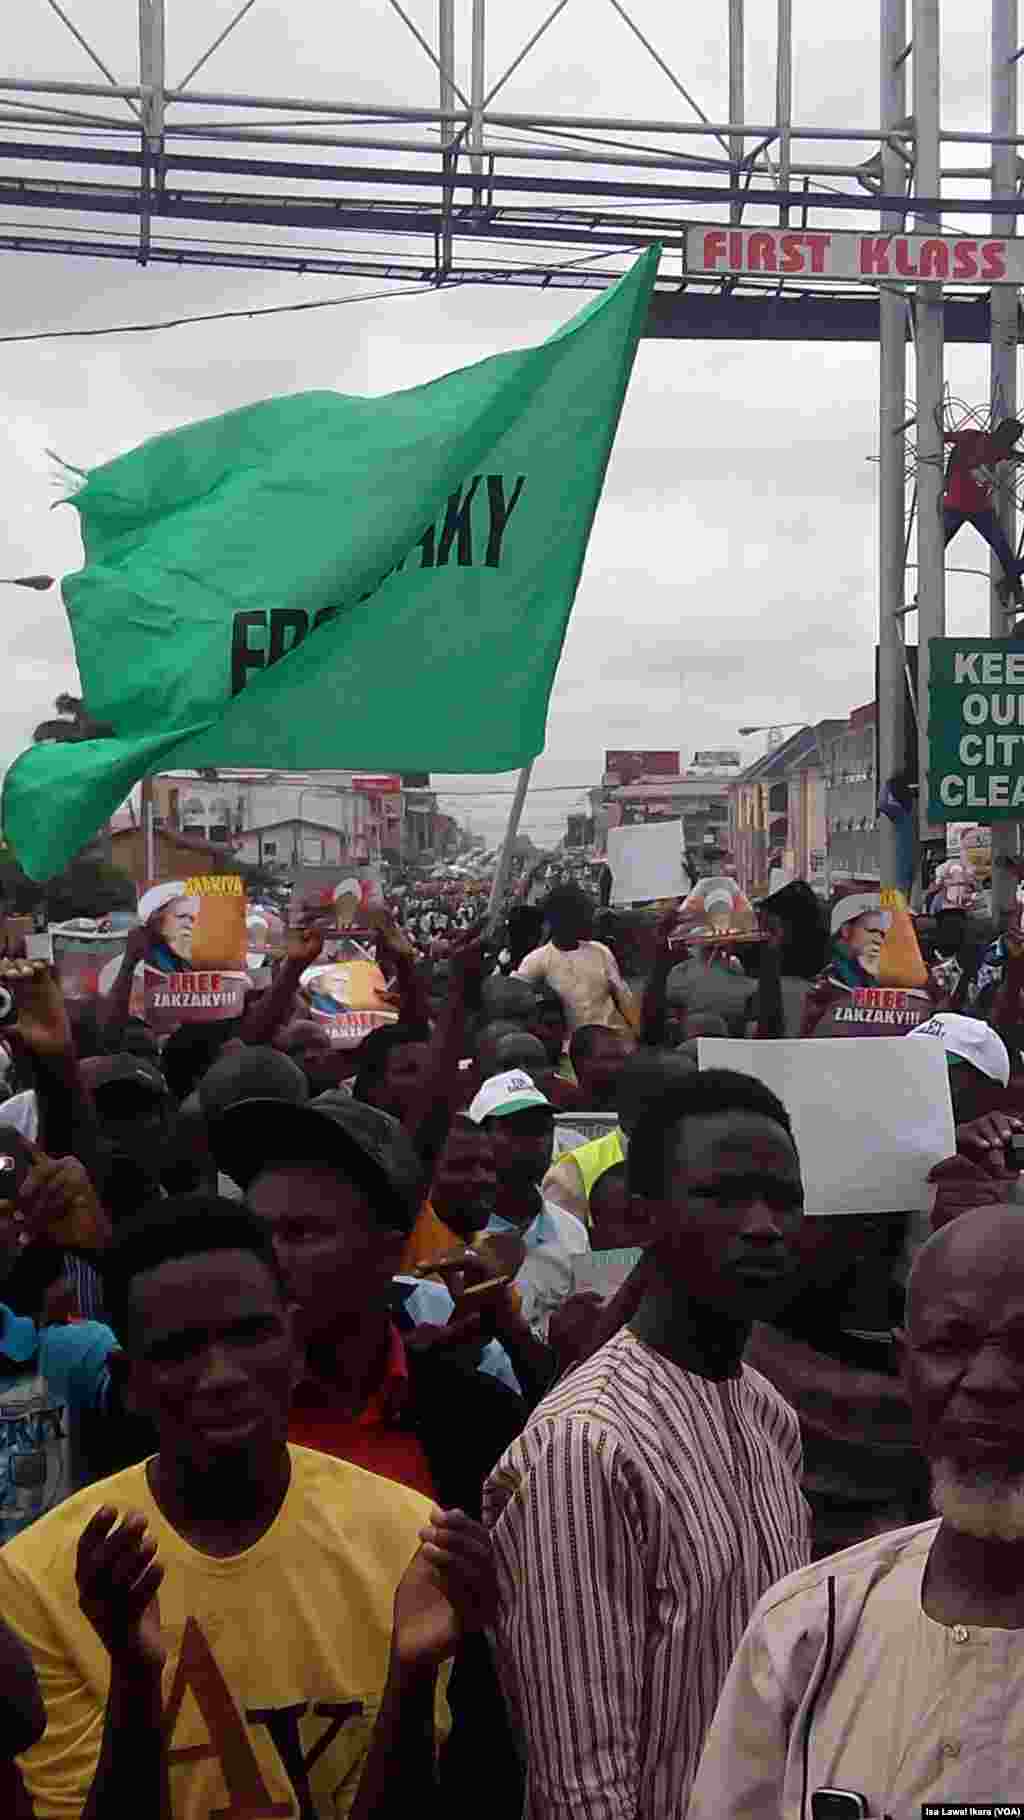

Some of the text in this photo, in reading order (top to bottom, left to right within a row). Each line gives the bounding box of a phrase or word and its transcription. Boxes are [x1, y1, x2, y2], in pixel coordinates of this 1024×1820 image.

[704, 231, 1008, 280] FIRST KLASS
[962, 693, 1024, 726] OU
[959, 734, 1024, 767] CIT
[153, 991, 237, 1008] ZAKZAKY!!!
[834, 1007, 921, 1025] ZAKZAKY!!!
